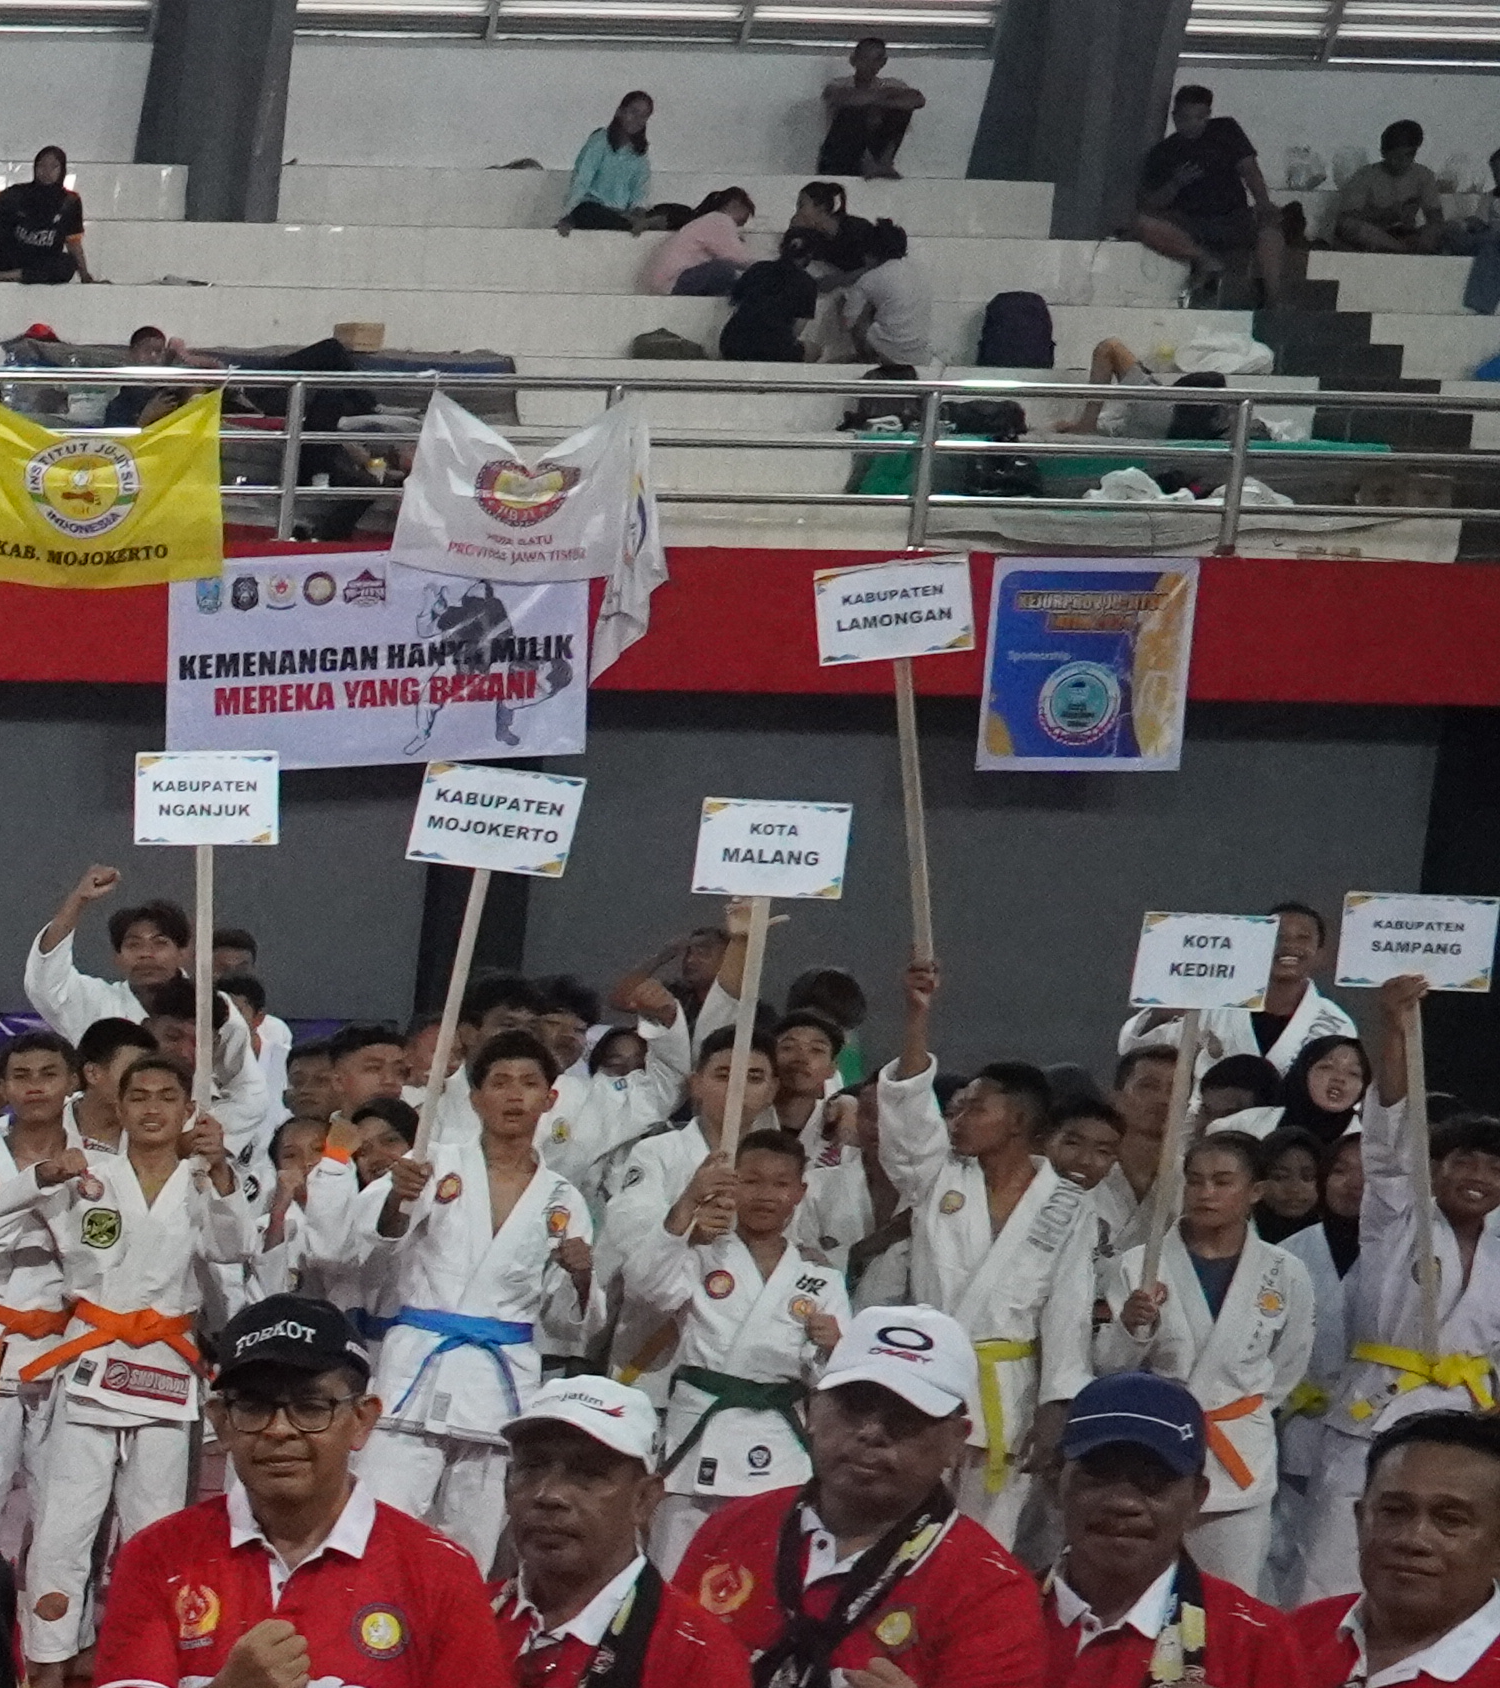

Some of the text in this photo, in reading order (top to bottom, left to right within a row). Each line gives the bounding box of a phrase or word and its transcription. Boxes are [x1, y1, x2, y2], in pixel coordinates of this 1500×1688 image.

[46, 544, 169, 567] MOJOKERTO
[840, 583, 945, 607] KABUPATEN
[836, 606, 954, 633] LAMONGAN
[179, 644, 379, 681] KEMENANGAN
[489, 634, 574, 664] MILIK
[213, 669, 538, 717] MEREKA YANG BERANI
[152, 779, 258, 793] KABUPATEN
[158, 803, 251, 818] NGANJUK
[434, 787, 566, 818] KABUPATEN
[426, 814, 560, 845] MOJOKERTO
[750, 823, 800, 837] KOTA
[722, 847, 821, 867] MALANG
[1372, 919, 1466, 933] KABUPATEN
[1182, 934, 1233, 951] KOTA
[1370, 939, 1463, 956] SAMPANG
[1169, 962, 1236, 979] KEDIRI
[233, 1320, 317, 1358] FORKOT
